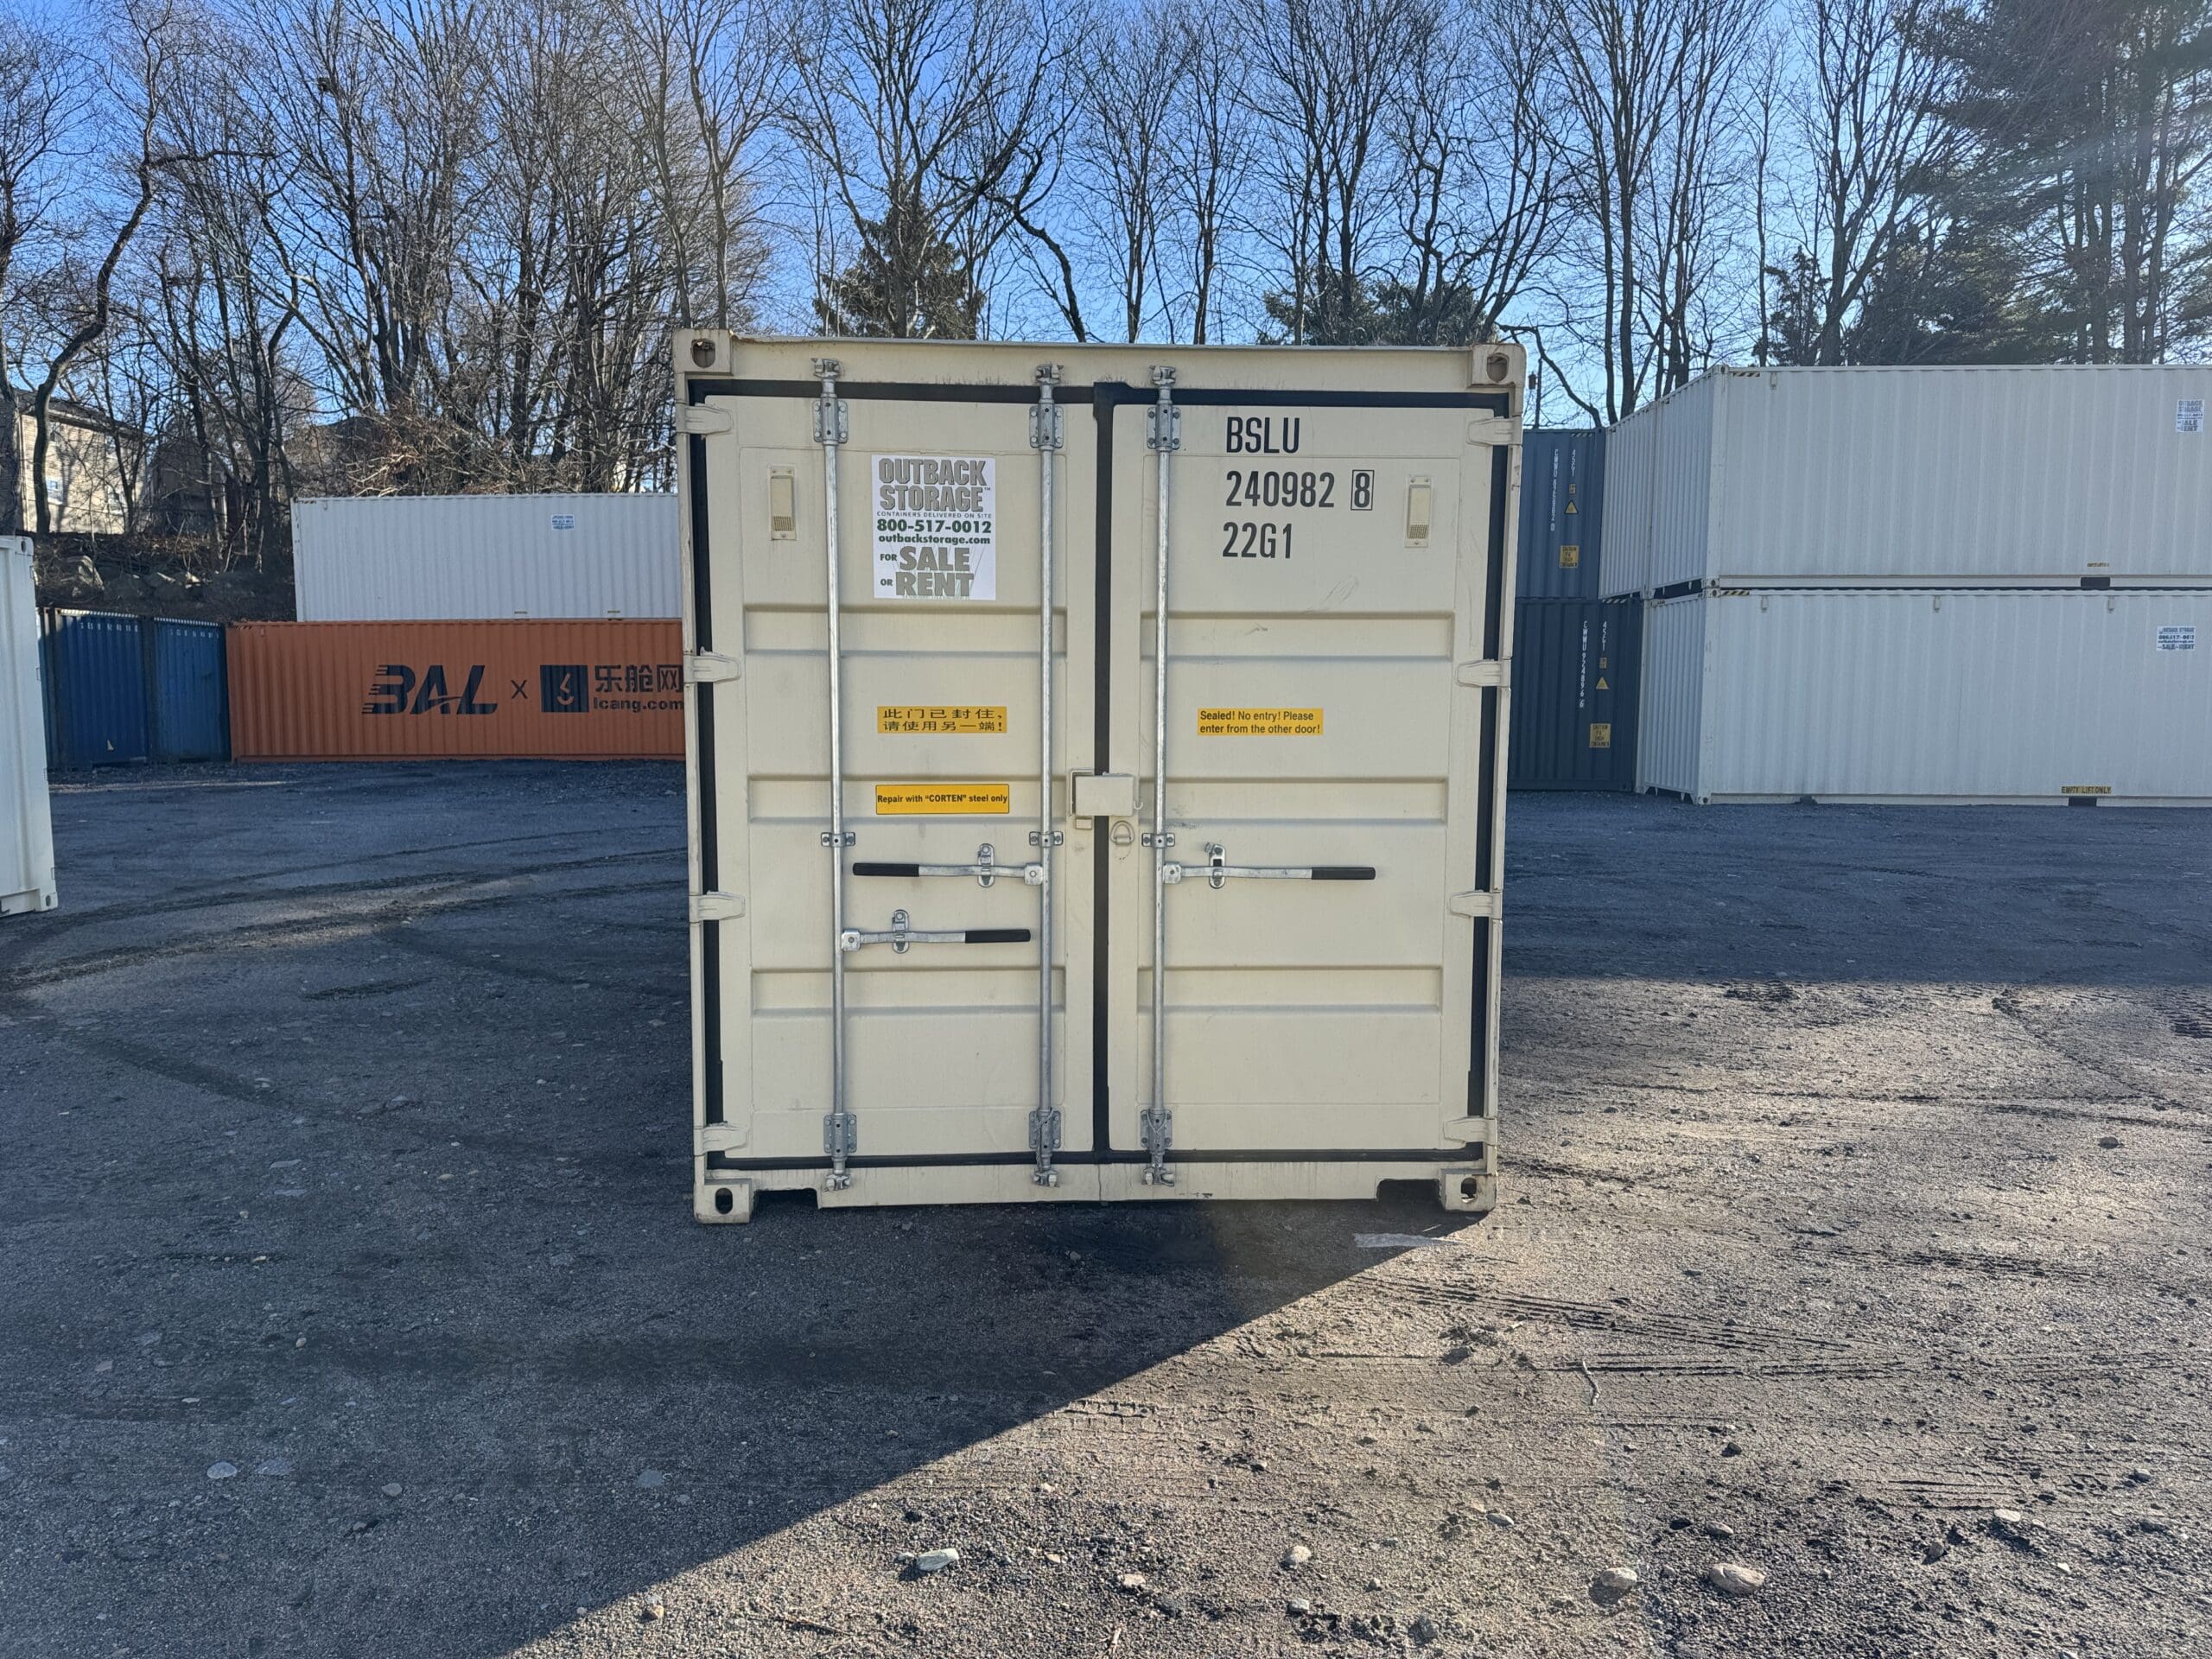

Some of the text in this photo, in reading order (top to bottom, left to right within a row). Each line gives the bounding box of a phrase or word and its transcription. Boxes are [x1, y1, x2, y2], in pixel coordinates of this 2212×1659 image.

[1226, 416, 1300, 454] BSLU
[879, 458, 987, 486] OUTBACK
[880, 485, 983, 512] STORAGE
[1225, 470, 1371, 509] 240982 8
[877, 518, 992, 534] 800-517-0012
[879, 533, 990, 546] outbackstorage.com
[1223, 522, 1292, 559] 22G1
[899, 546, 970, 572] SALE
[880, 571, 974, 597] OR RENT
[361, 664, 498, 715] BAL
[594, 664, 684, 693] 乐舱网
[1199, 710, 1314, 722] Sealed! No entry! Please
[1199, 723, 1320, 734] enter from the other door!
[877, 795, 904, 804] Repair
[969, 794, 988, 803] steel
[990, 794, 1007, 804] only
